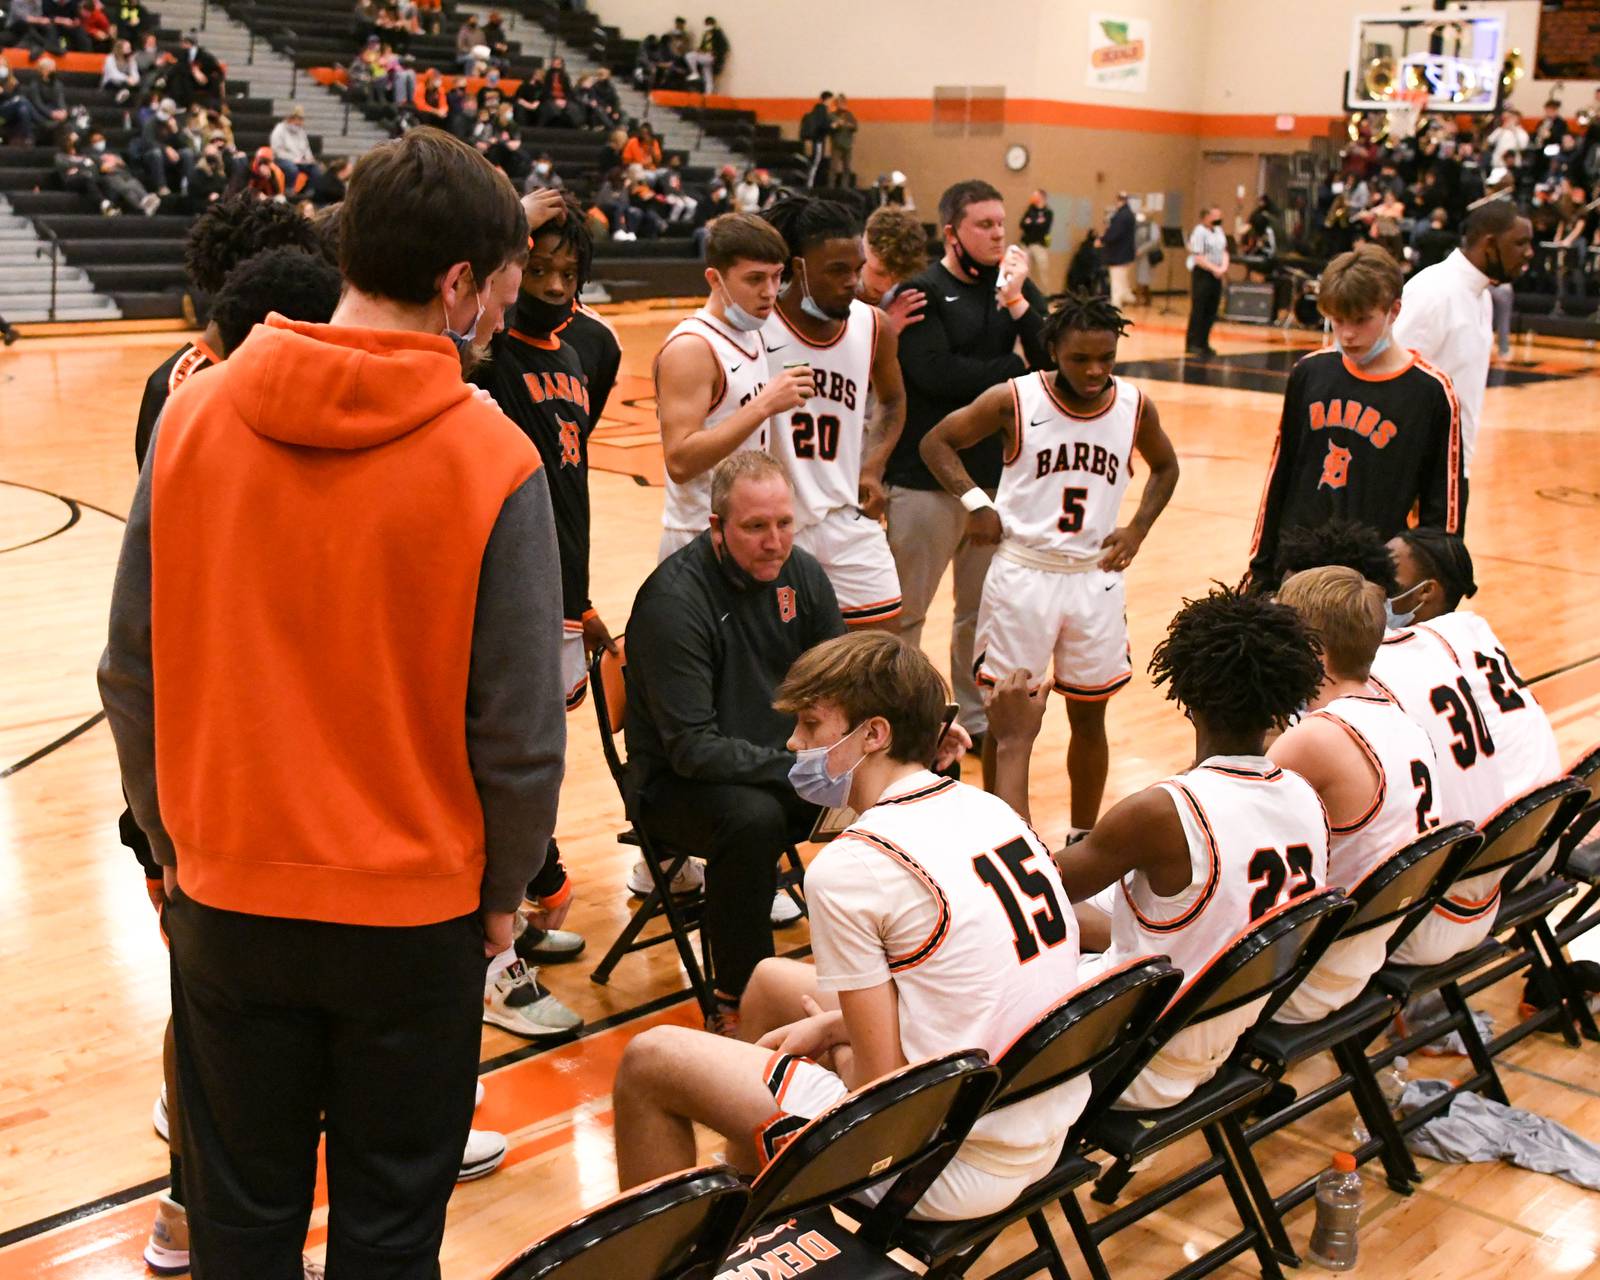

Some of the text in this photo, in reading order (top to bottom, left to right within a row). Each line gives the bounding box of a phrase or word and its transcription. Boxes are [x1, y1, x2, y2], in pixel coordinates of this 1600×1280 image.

[813, 368, 857, 411] RBS
[791, 412, 841, 461] 20
[1308, 398, 1398, 449] BARBS
[1036, 442, 1119, 485] BARBS
[1057, 487, 1088, 535] 5
[1430, 673, 1495, 771] 30
[971, 834, 1067, 965] 15
